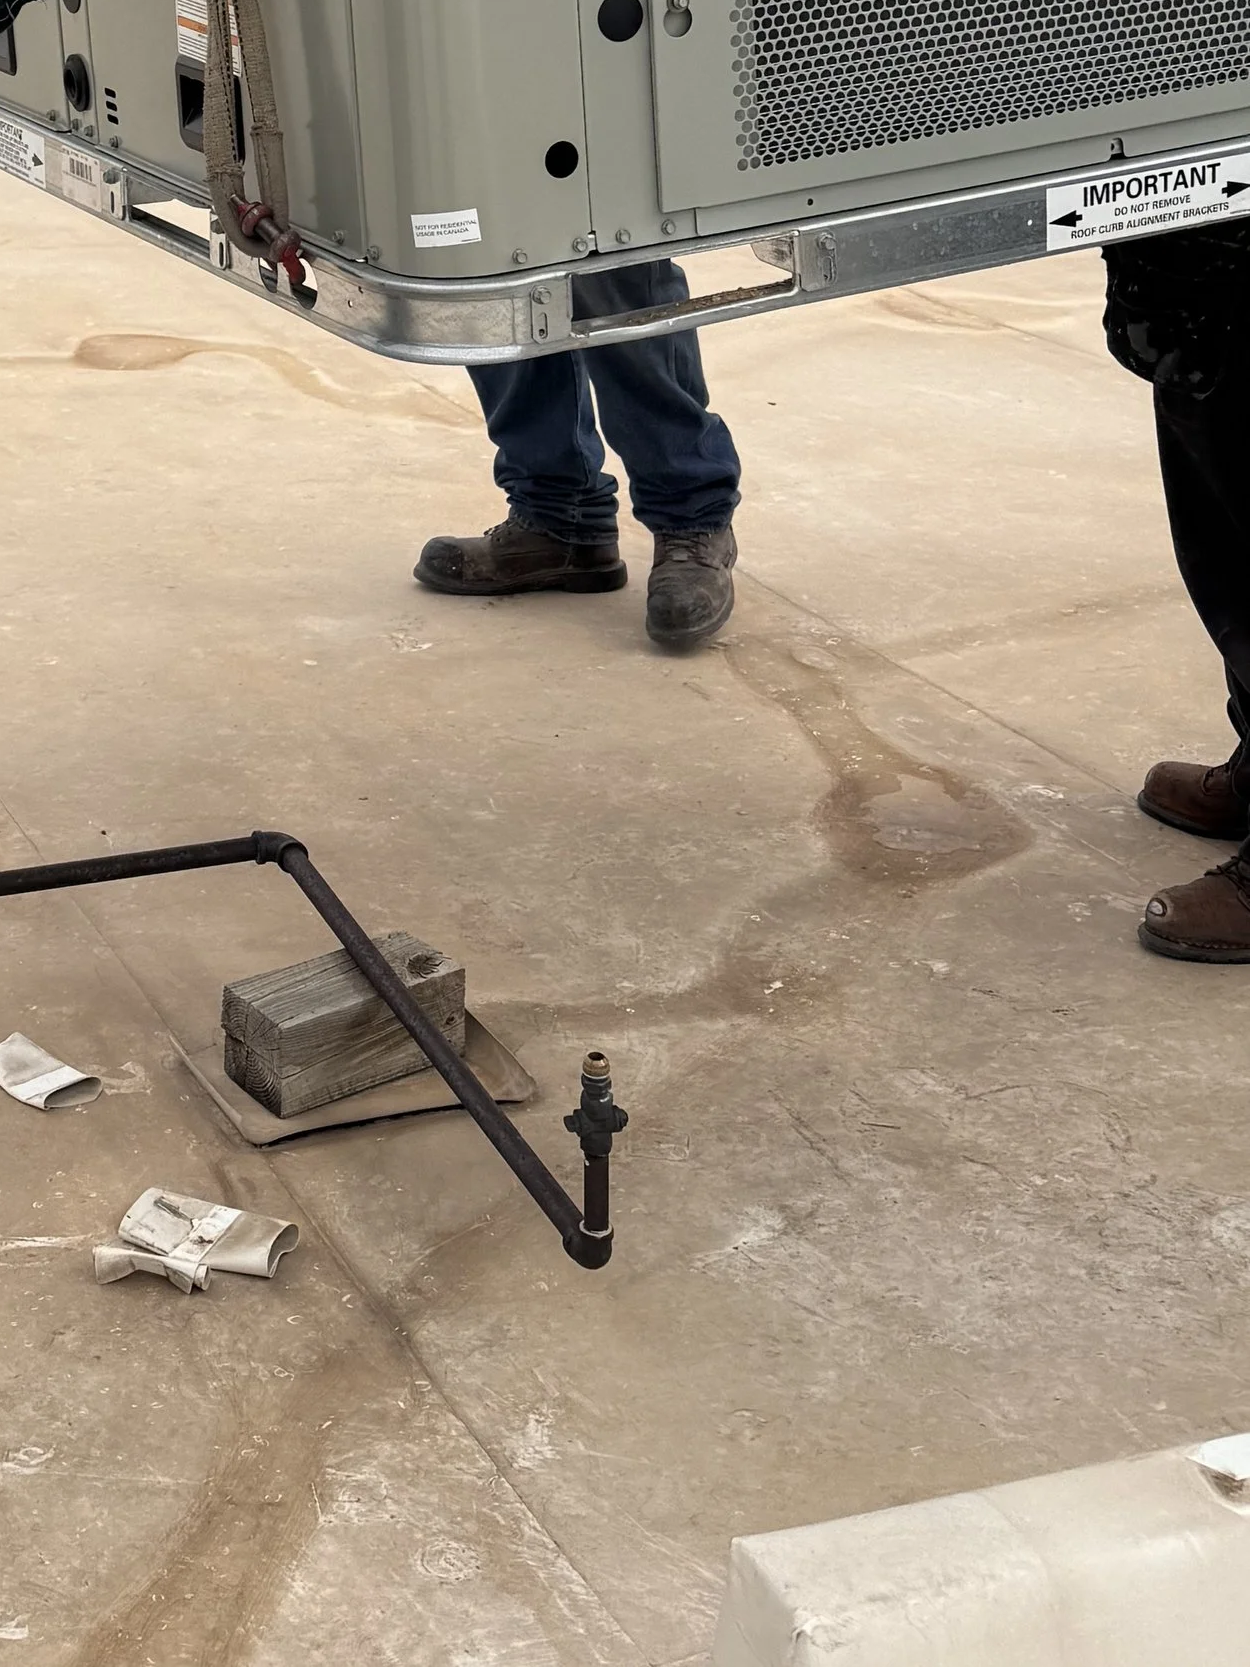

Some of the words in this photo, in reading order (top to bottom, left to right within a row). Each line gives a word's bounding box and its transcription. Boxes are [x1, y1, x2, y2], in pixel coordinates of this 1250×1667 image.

[1083, 163, 1222, 208] IMPORTANT
[1114, 207, 1129, 217] DO
[1130, 201, 1149, 214] NOT
[1152, 194, 1192, 211] REMOVE
[440, 219, 477, 229] RESIDENTIAL
[1070, 226, 1097, 239] ROOF
[1098, 221, 1124, 235] CURB
[1126, 210, 1181, 229] ALIGNMENT
[1183, 201, 1230, 219] BRACKETS
[416, 229, 435, 237] USAGE
[443, 227, 469, 236] CANADA
